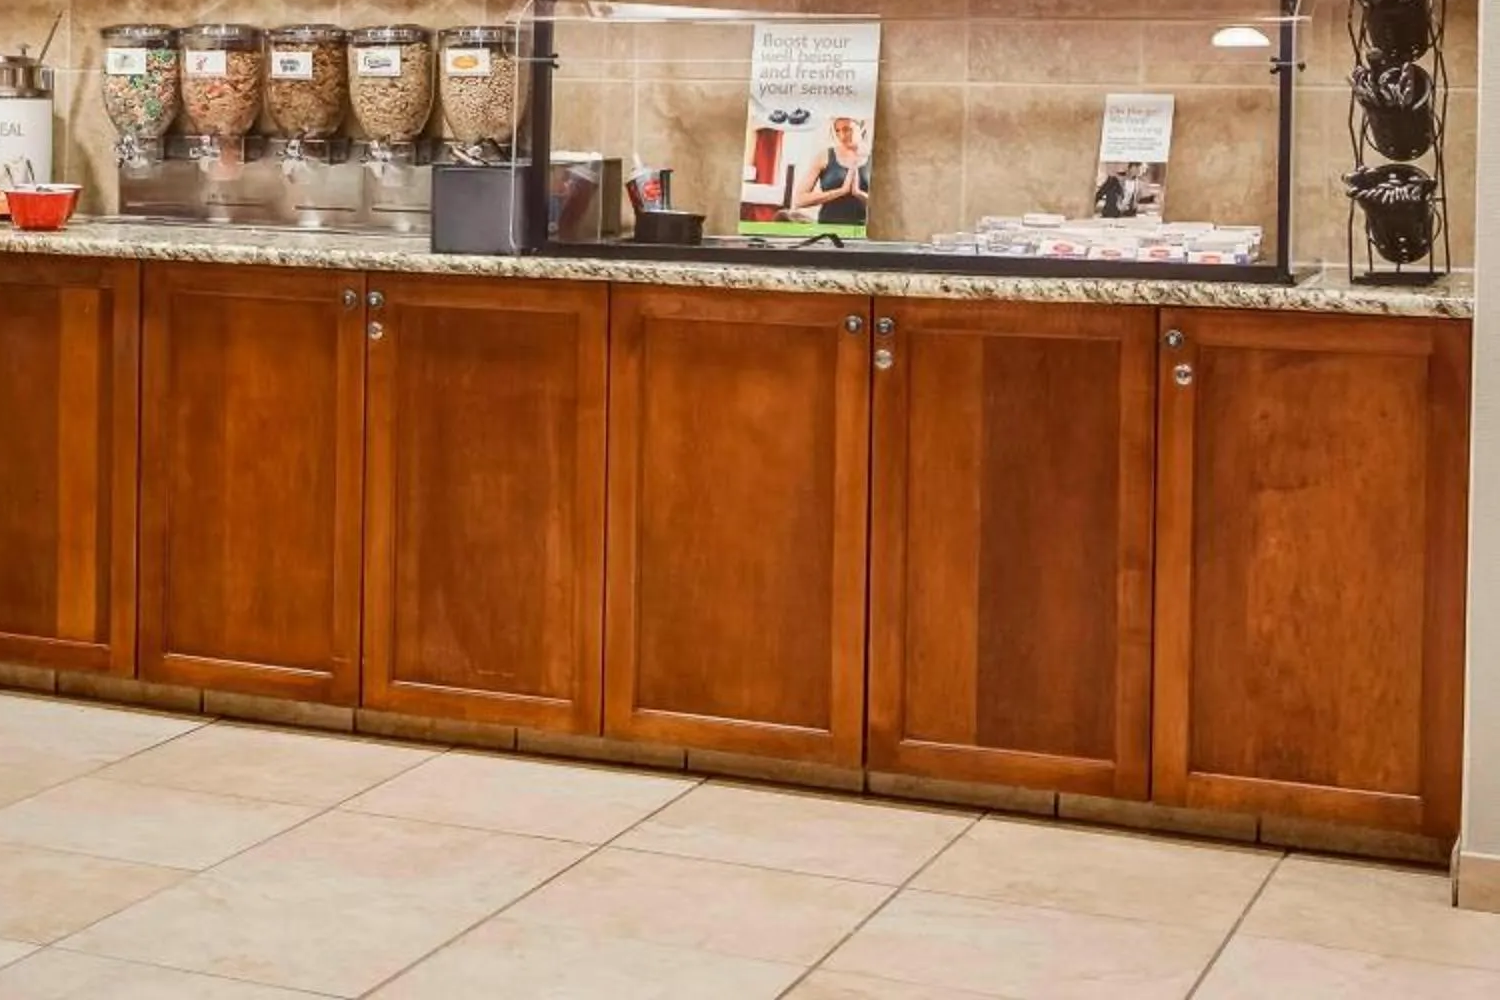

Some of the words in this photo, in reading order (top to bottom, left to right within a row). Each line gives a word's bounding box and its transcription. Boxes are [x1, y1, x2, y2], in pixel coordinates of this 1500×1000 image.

[762, 32, 808, 48] Boost
[813, 36, 852, 52] your
[761, 48, 793, 62] well
[798, 49, 844, 68] being
[759, 63, 791, 80] and
[795, 63, 856, 80] freshen
[759, 82, 798, 99] your
